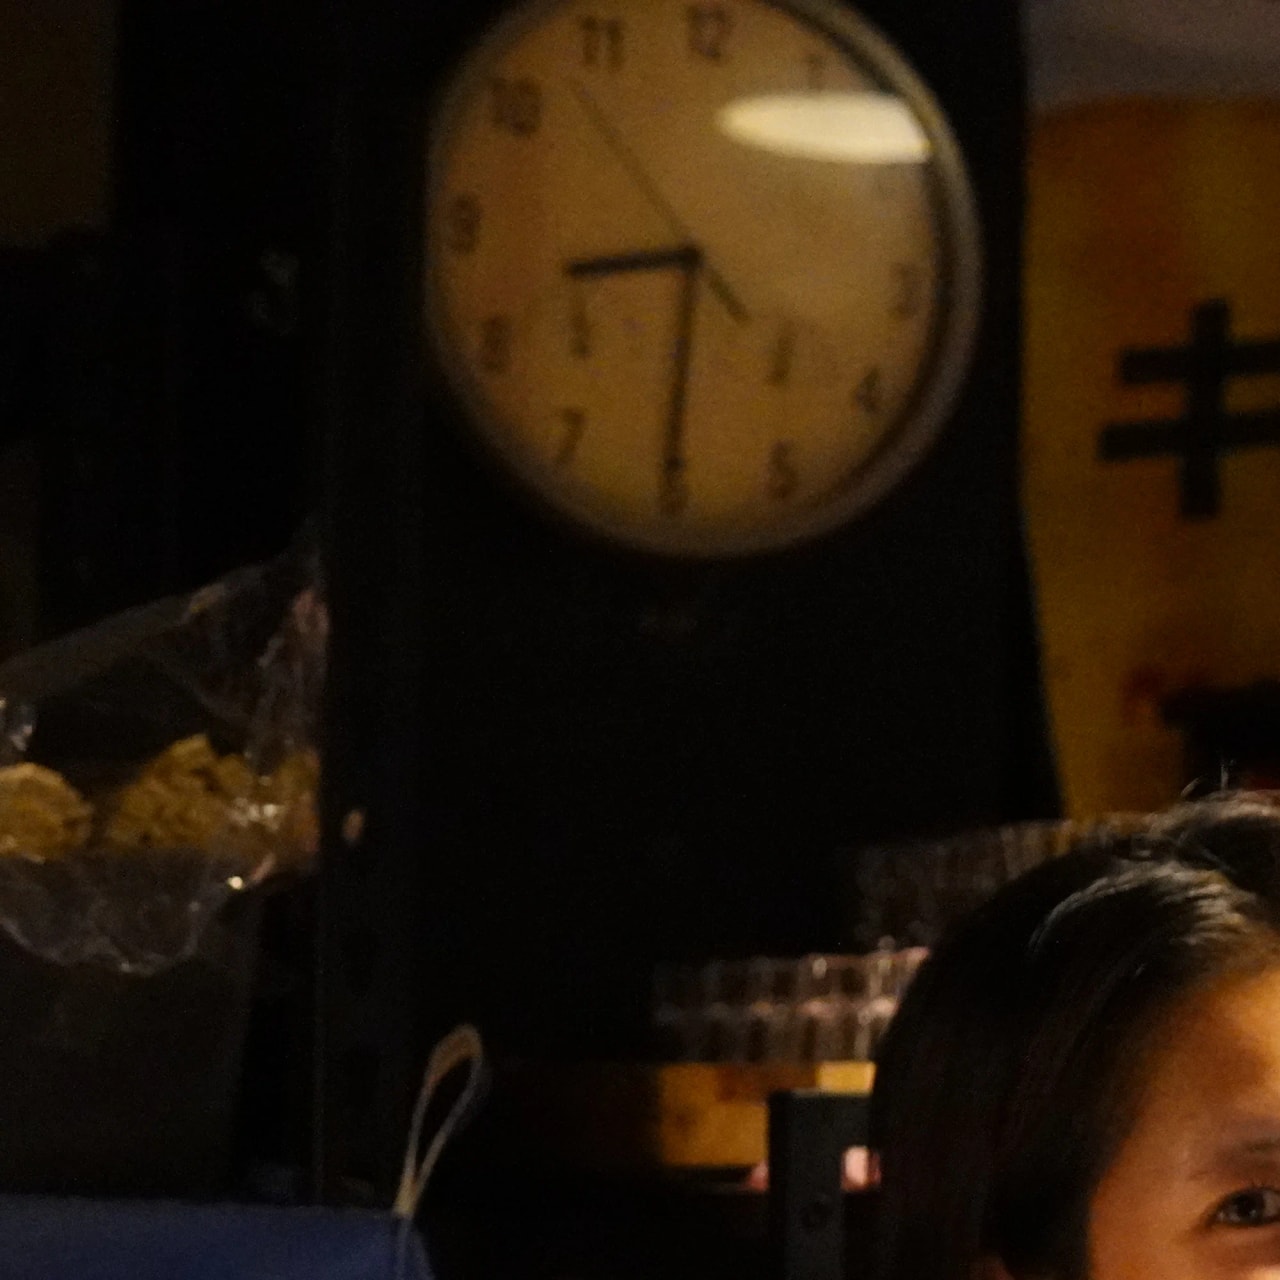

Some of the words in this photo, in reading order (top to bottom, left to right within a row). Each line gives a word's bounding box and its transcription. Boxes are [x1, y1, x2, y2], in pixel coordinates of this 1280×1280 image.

[579, 15, 624, 71] 11
[686, 5, 734, 63] 12
[491, 78, 542, 138] 10
[447, 194, 481, 254] 9
[479, 315, 512, 374] 8
[854, 364, 882, 414] 4
[556, 407, 585, 467] 7
[765, 439, 799, 500] 5
